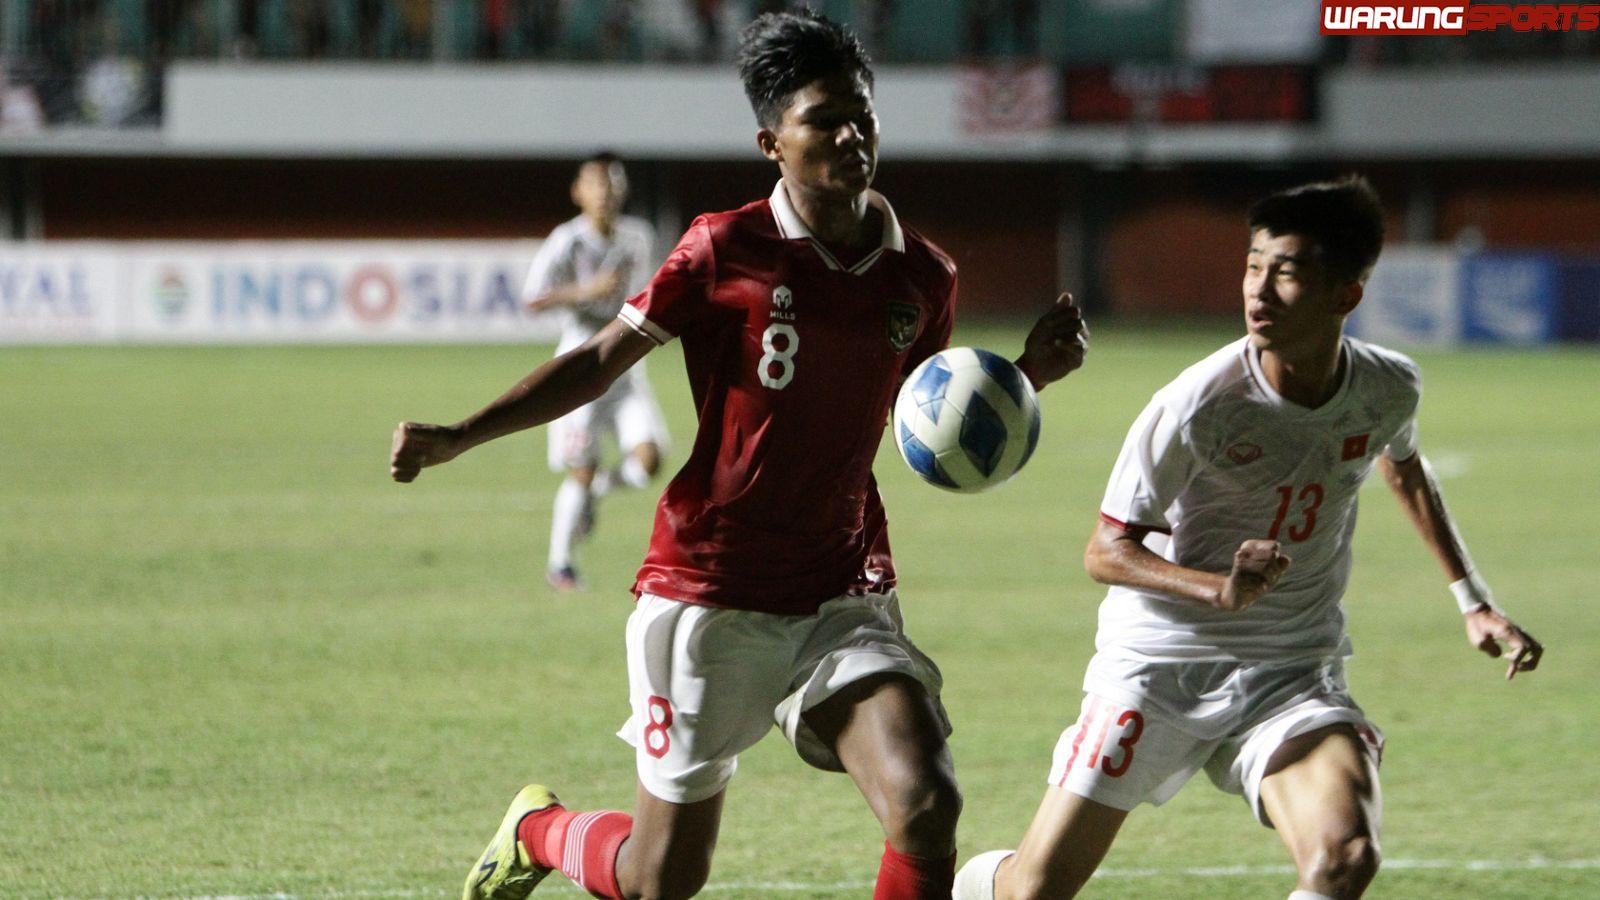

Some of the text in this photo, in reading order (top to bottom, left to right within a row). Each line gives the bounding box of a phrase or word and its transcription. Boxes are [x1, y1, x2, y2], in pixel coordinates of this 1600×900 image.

[769, 310, 796, 321] MILLS
[757, 322, 800, 390] 8
[1268, 483, 1324, 543] 13
[643, 694, 673, 759] 8
[1087, 705, 1144, 777] 13
